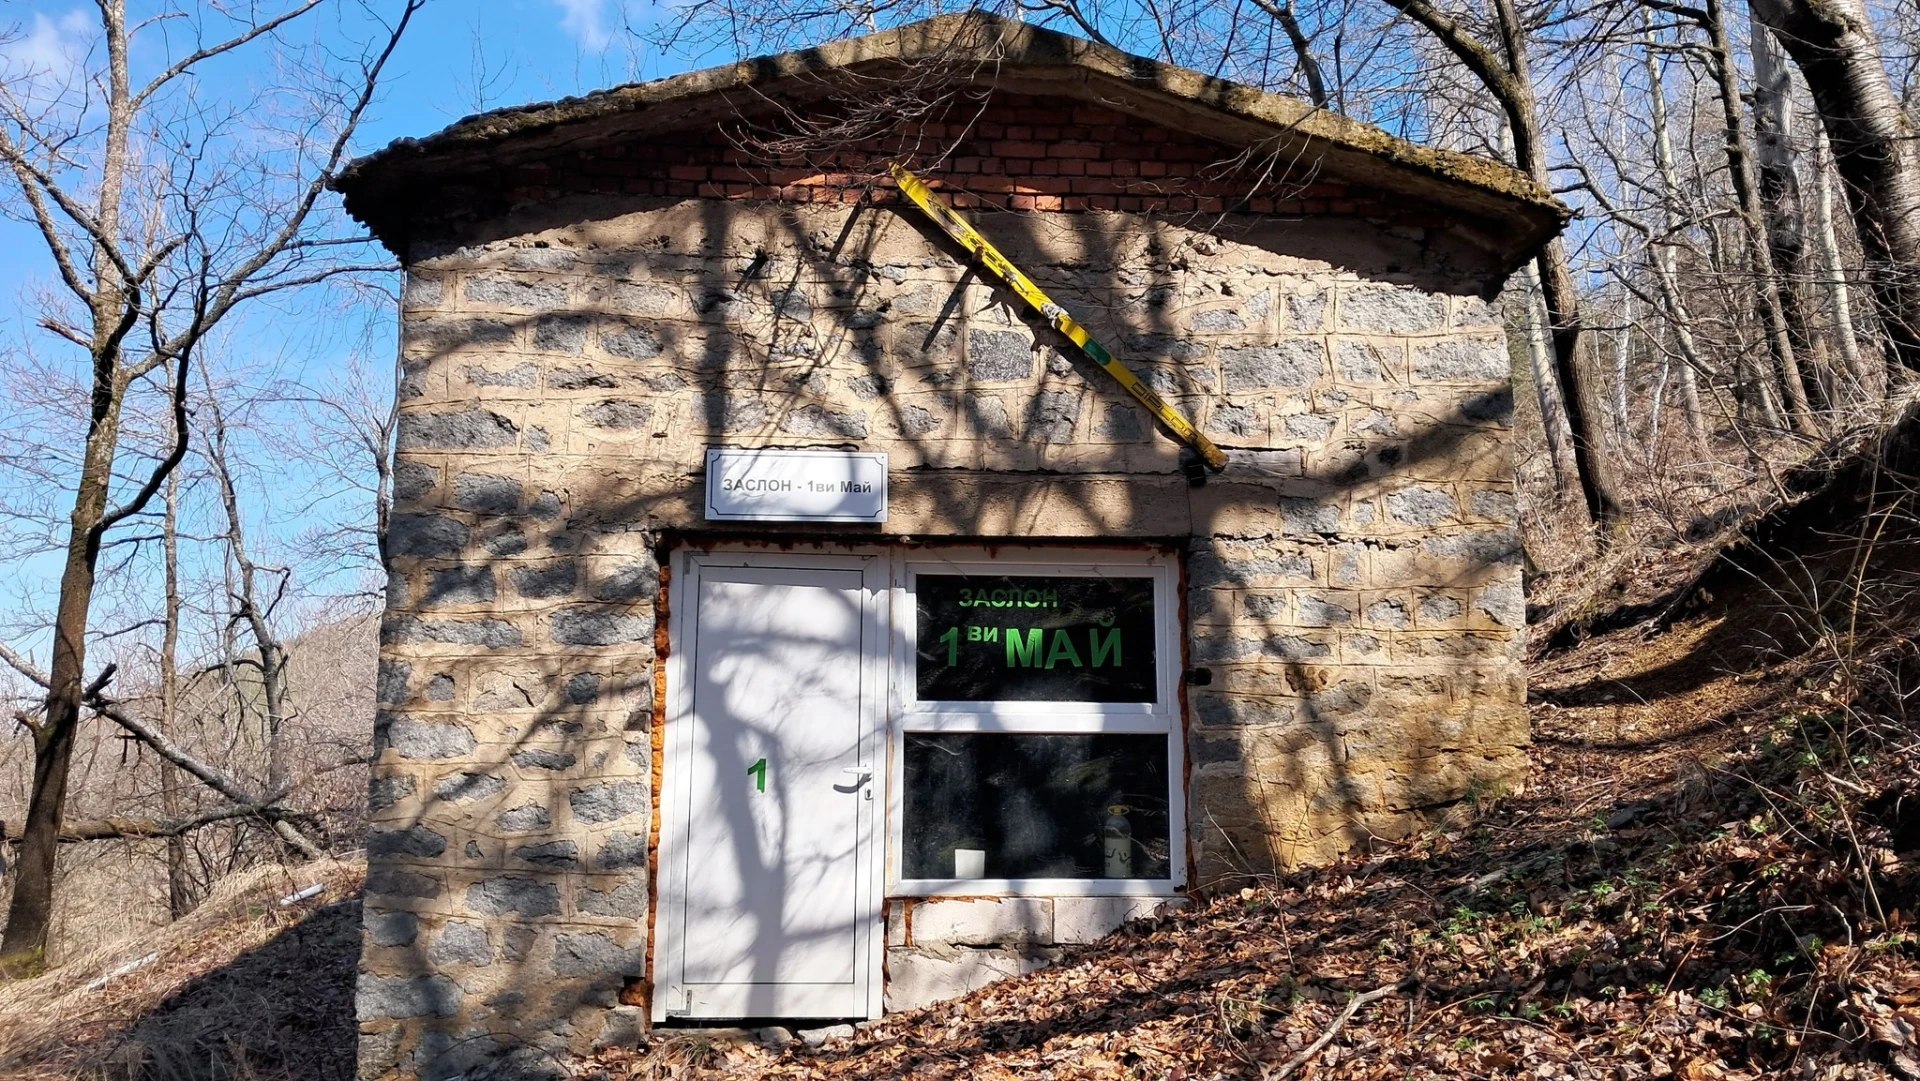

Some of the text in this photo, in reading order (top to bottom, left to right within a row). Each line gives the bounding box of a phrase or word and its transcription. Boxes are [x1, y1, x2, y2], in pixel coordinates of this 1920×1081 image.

[723, 478, 791, 492] ЗАСЛОН
[807, 480, 835, 493] 1ви
[840, 480, 872, 493] Май
[959, 588, 1058, 608] ЗАСЛОН
[1006, 617, 1122, 669] МАЙ
[747, 758, 767, 793] 1
